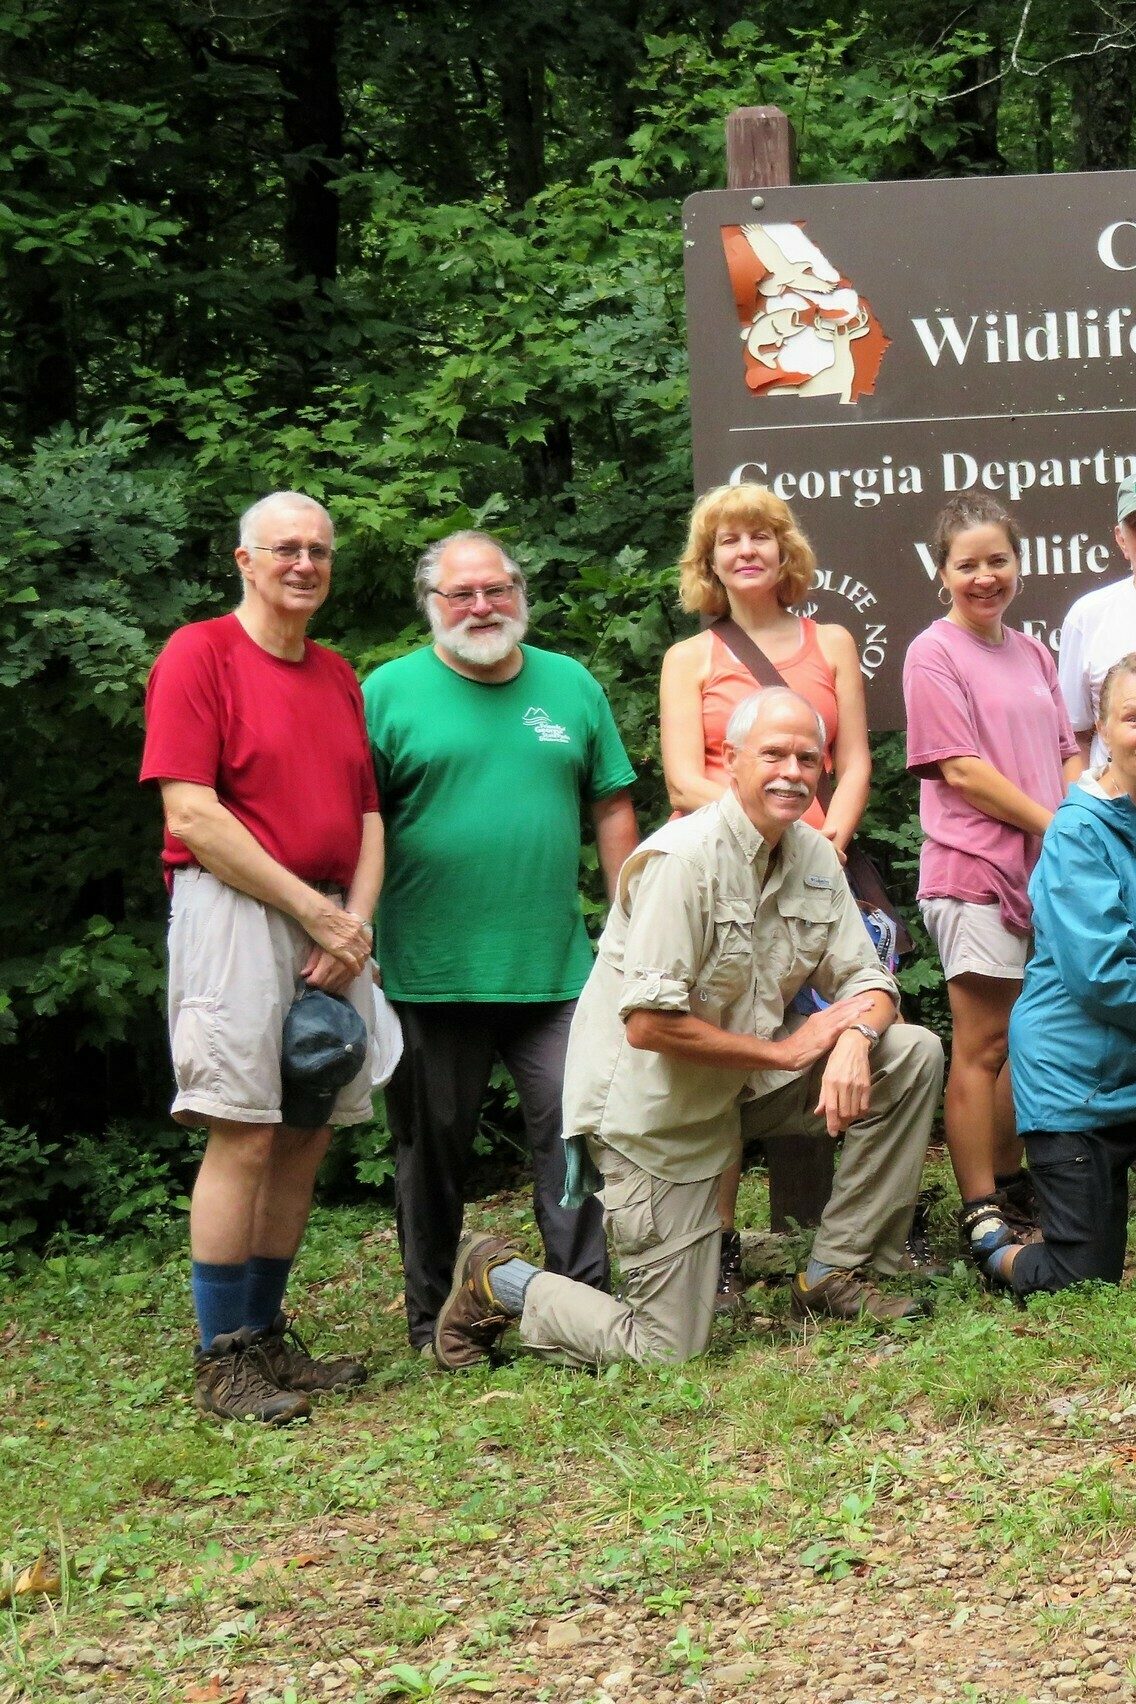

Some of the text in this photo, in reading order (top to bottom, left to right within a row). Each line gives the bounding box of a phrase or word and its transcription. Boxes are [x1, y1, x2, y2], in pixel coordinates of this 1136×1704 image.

[729, 455, 924, 508] Georgia
[914, 533, 1110, 581] life
[807, 569, 878, 613] DLIFE
